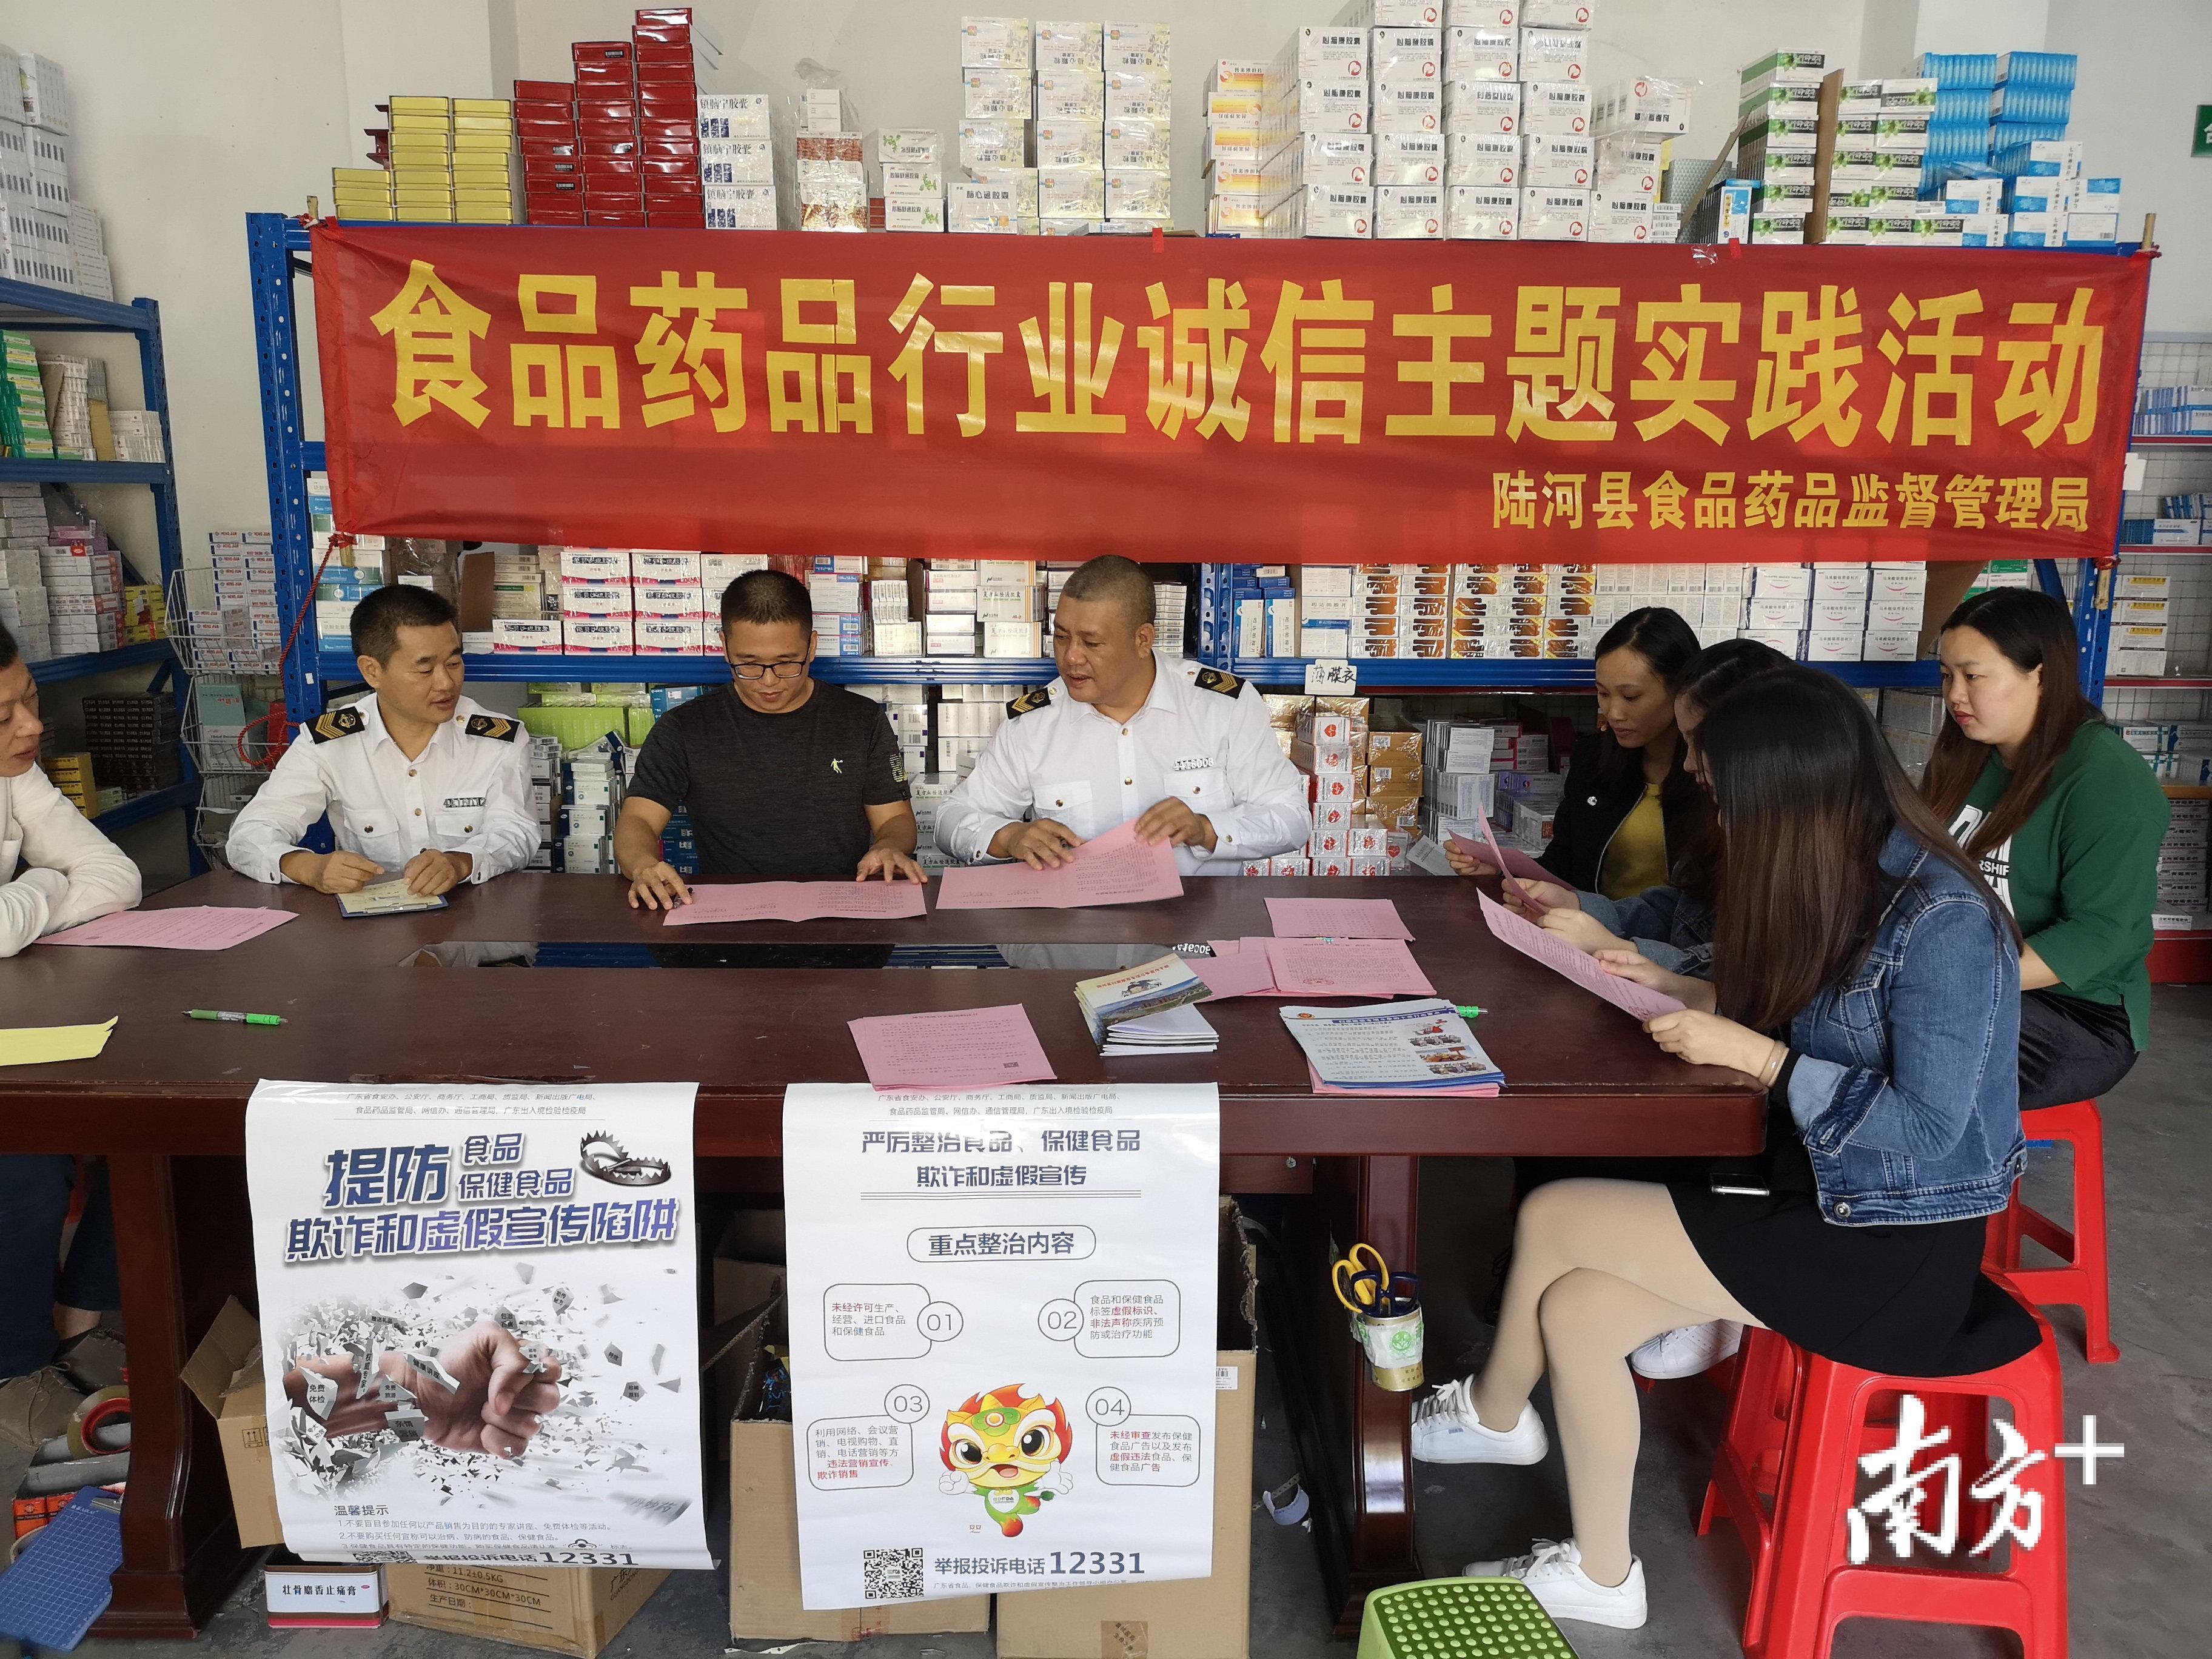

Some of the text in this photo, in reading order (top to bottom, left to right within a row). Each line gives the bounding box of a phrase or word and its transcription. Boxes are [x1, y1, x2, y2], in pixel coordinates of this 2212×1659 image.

[369, 260, 2103, 449] 食品药品行业诚信主题实践活动
[1492, 470, 2089, 532] 陆河县食品药品监督管理局
[463, 1133, 523, 1164] 食品
[323, 1144, 450, 1207] 提防
[917, 1165, 1087, 1187] 欺诈和虚假宣传
[458, 1167, 572, 1201] 保健食品
[287, 1199, 678, 1260] 欺诈和虚假宣传陷阱
[928, 1232, 1074, 1256] 重点整治内容
[1090, 1295, 1164, 1305] 食品和保健食品
[832, 1315, 906, 1326] 经营、进口食品
[927, 1314, 953, 1331] 01
[1047, 1312, 1078, 1329] 02
[1090, 1318, 1164, 1328] 非法声称疾病预
[832, 1326, 885, 1336] 和保健食品
[1090, 1330, 1153, 1340] 防或治疗功能
[309, 1384, 326, 1393] 免费
[894, 1395, 923, 1413] 03
[1096, 1399, 1125, 1416] 04
[816, 1425, 898, 1437] 利用网络、会议营
[1110, 1430, 1193, 1441] 未经审查发布保健
[816, 1436, 899, 1447] 销、电视购物、直
[1110, 1441, 1193, 1452] 食品广告以及发布
[816, 1448, 899, 1458] 销、电话营销等方
[1110, 1452, 1193, 1463] 虚假违法食品、保
[1110, 1463, 1161, 1473] 健食品广告
[817, 1470, 858, 1480] 欺诈销售
[333, 1504, 389, 1517] 温馨提示
[282, 1583, 357, 1597] 壮骨麝香止痛膏
